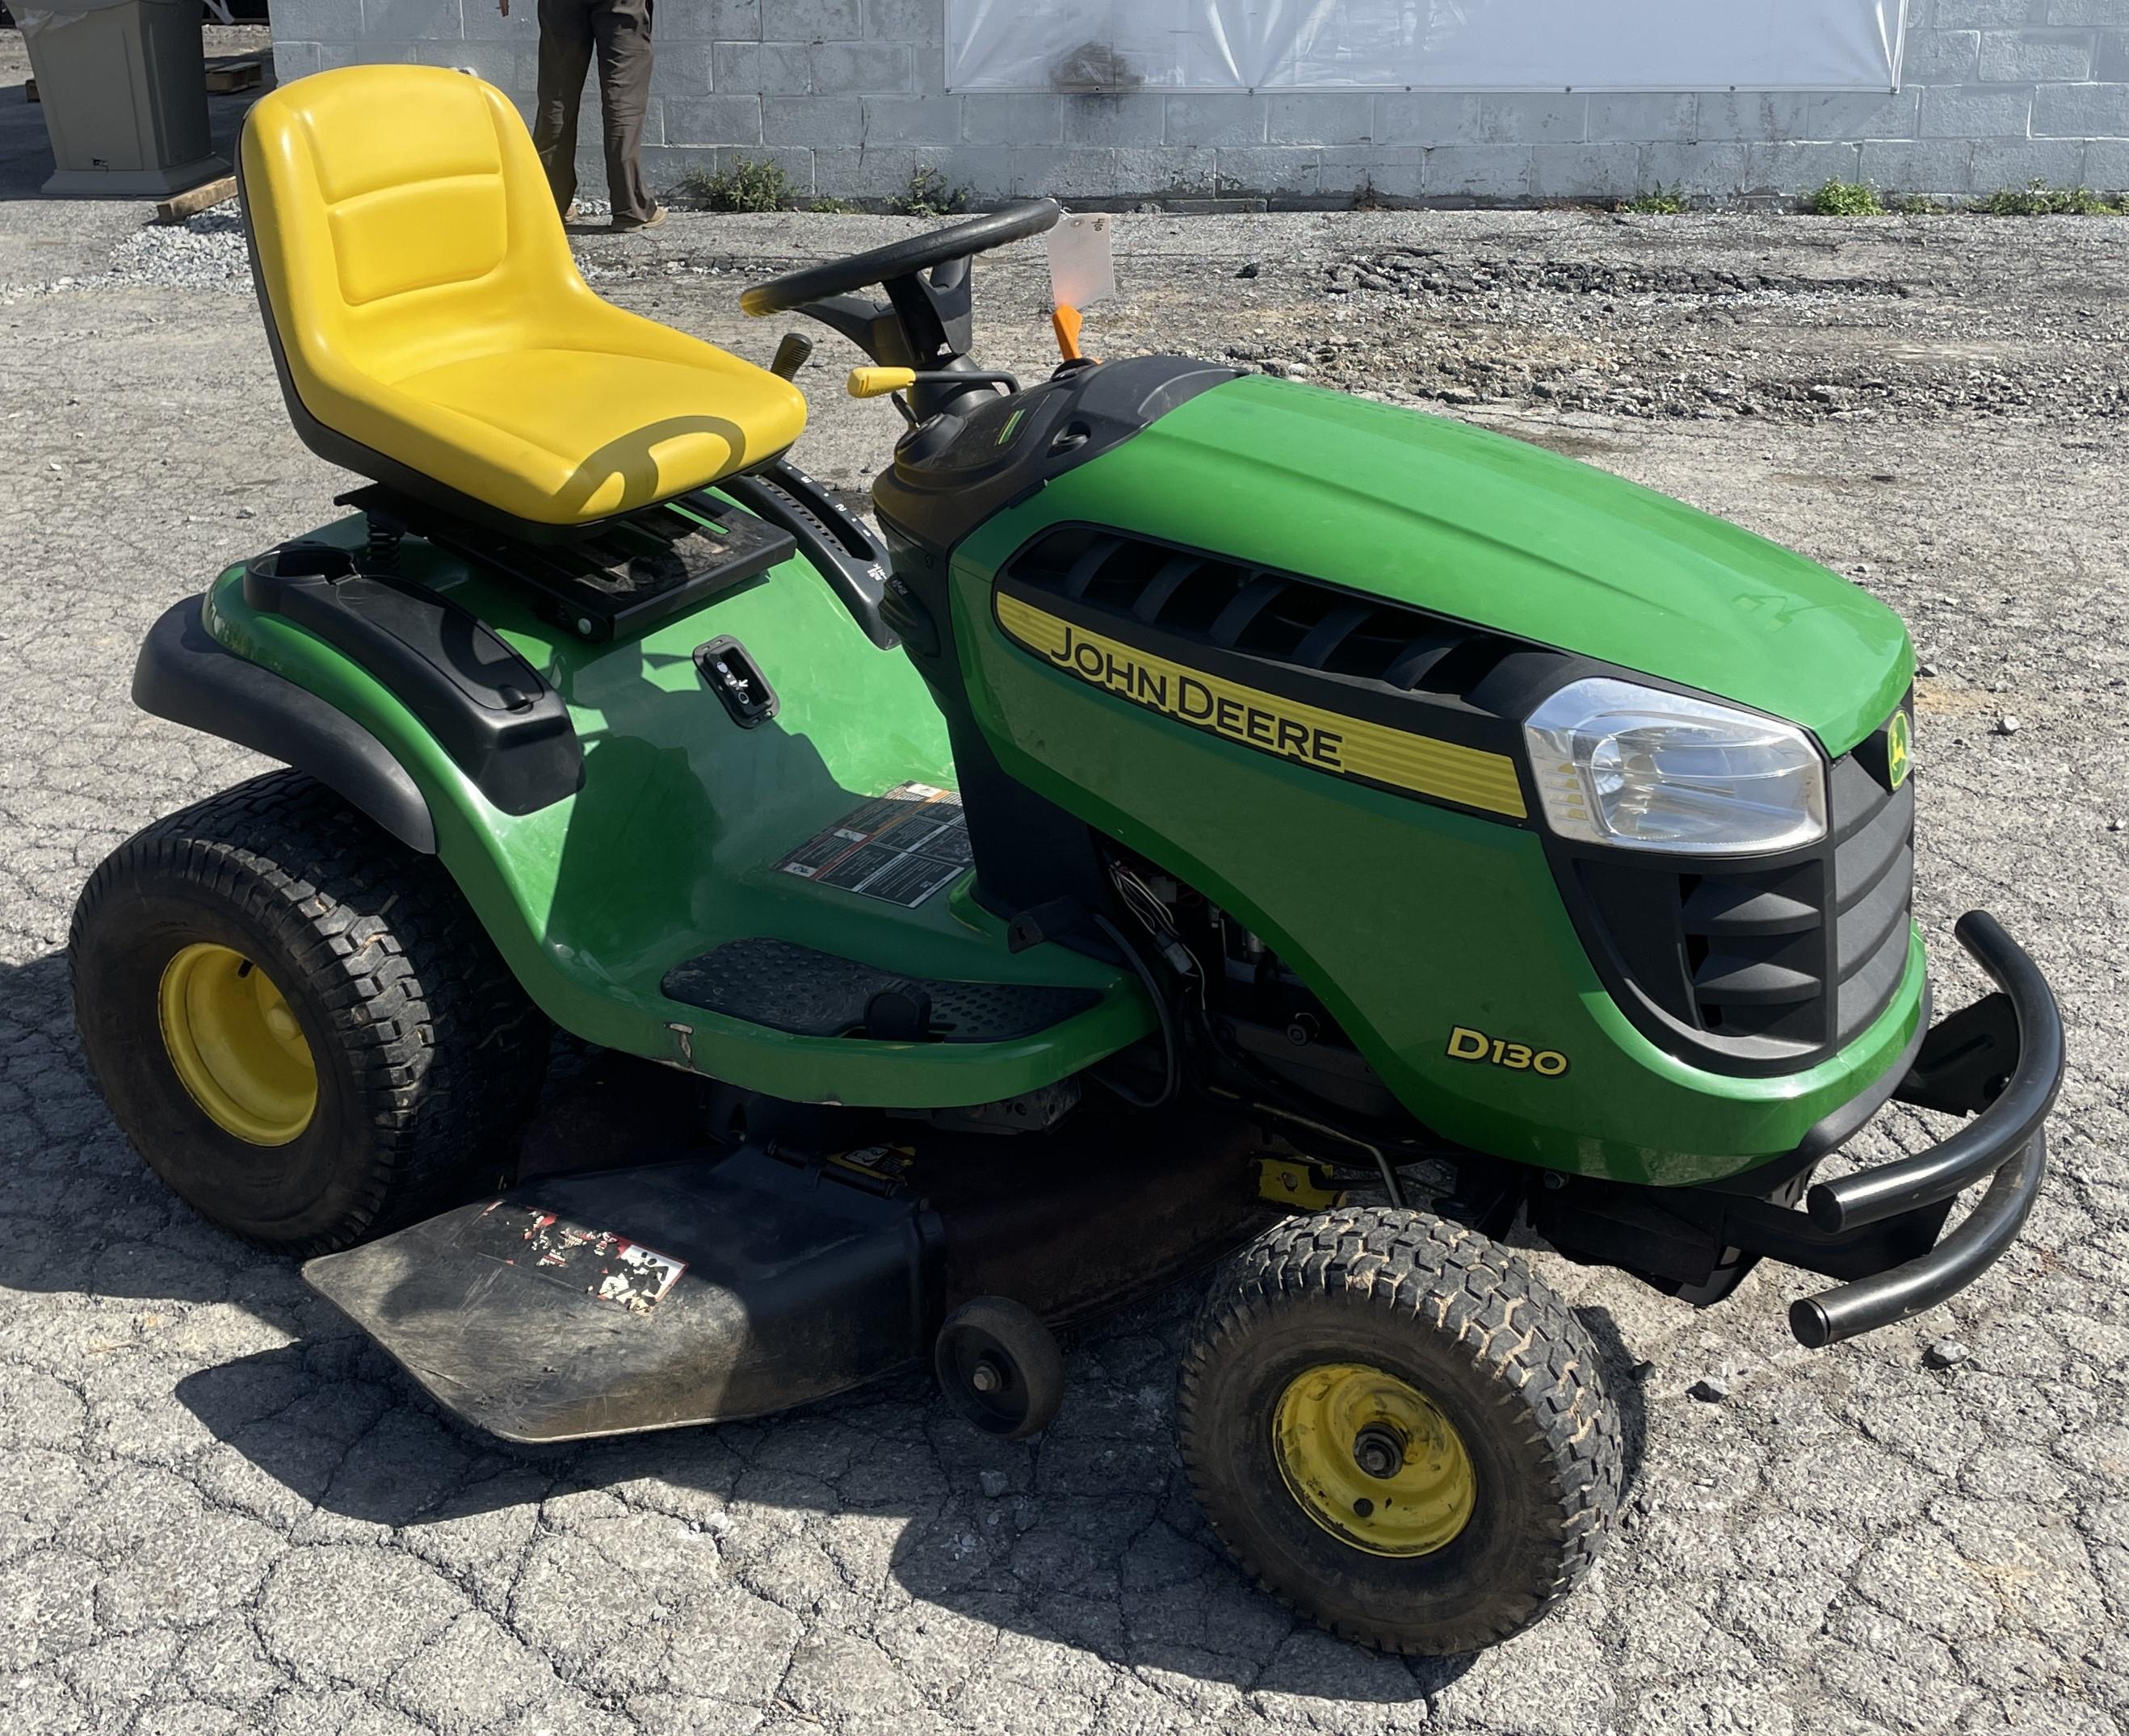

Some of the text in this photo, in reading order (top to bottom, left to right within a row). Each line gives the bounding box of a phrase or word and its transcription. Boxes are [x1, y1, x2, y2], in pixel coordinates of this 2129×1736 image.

[1050, 627, 1342, 766] JOHN DEERE
[1447, 1026, 1568, 1076] D130
